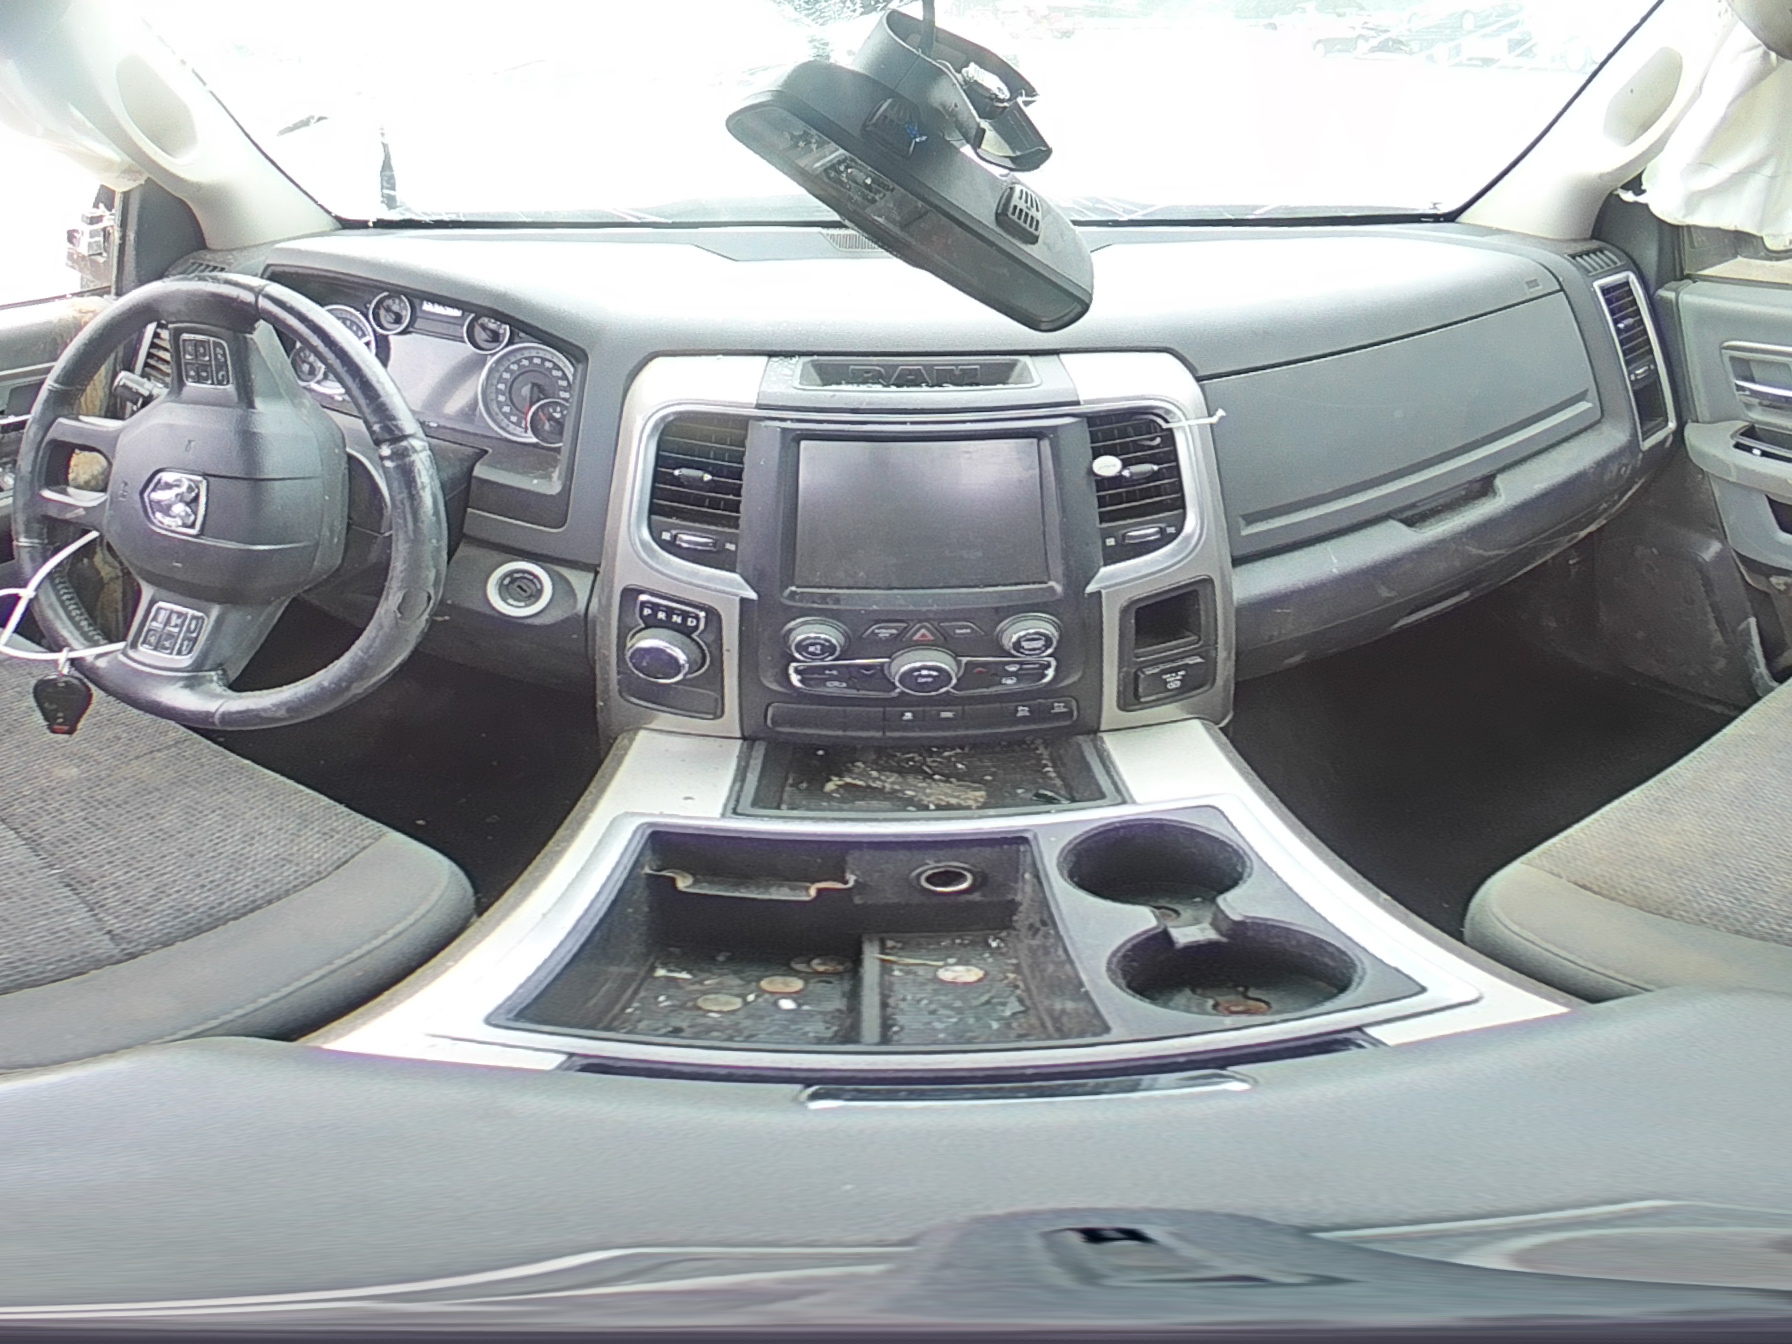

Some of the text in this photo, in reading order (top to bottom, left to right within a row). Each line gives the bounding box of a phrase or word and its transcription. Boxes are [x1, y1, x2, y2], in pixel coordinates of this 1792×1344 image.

[848, 365, 981, 387] RAM
[643, 607, 697, 627] P R N D
